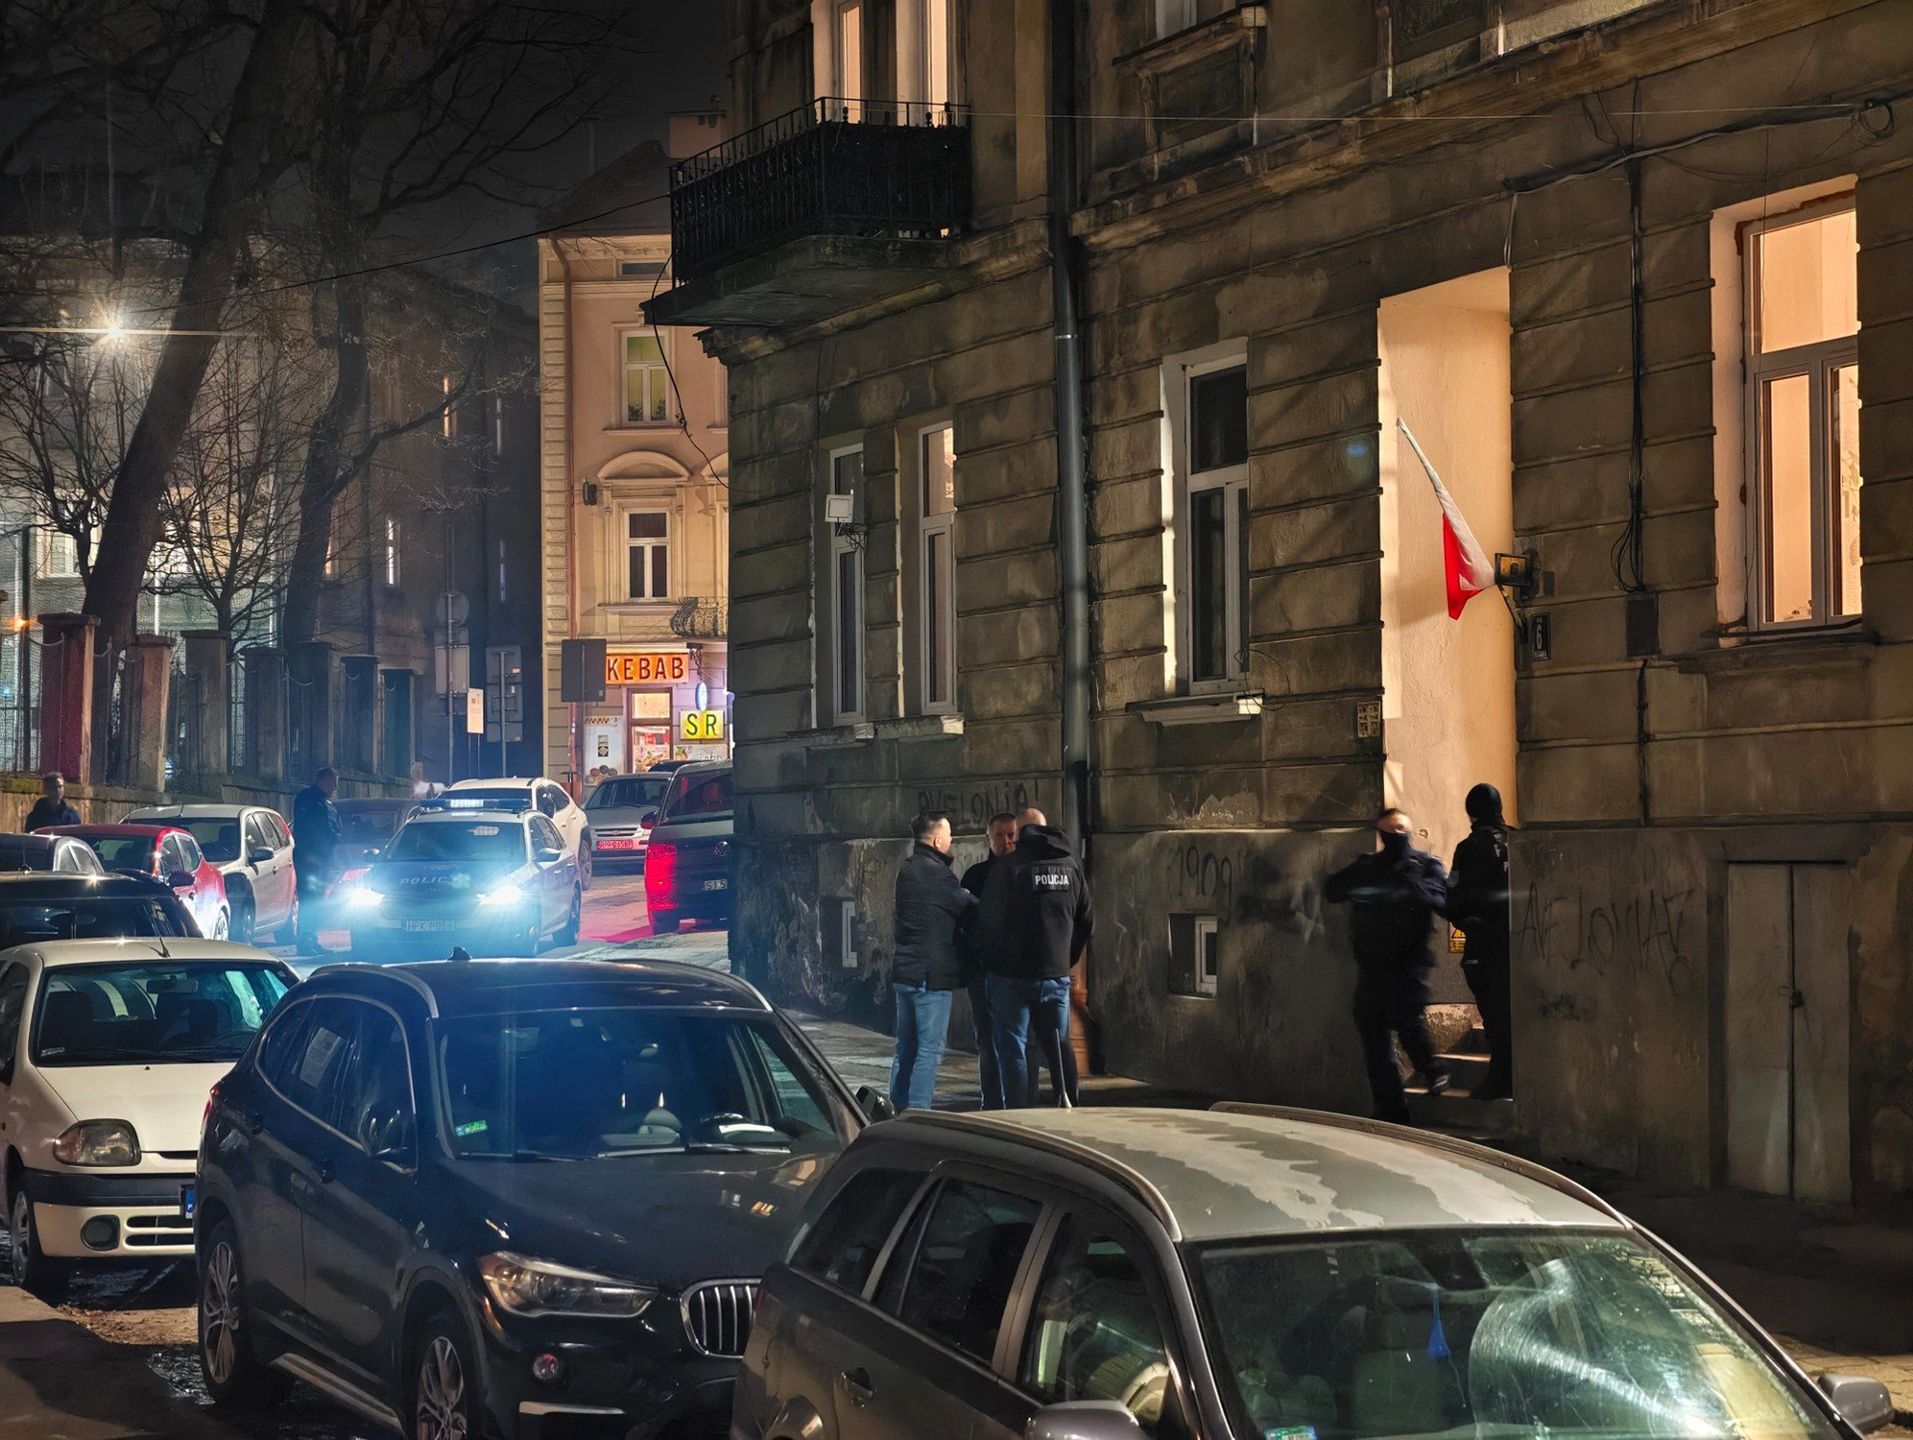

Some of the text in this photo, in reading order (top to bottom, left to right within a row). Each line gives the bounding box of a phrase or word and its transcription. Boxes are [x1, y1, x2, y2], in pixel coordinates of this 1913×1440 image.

[607, 657, 684, 681] KEBAB
[400, 875, 468, 886] POLIC
[1034, 873, 1070, 886] POLICJA
